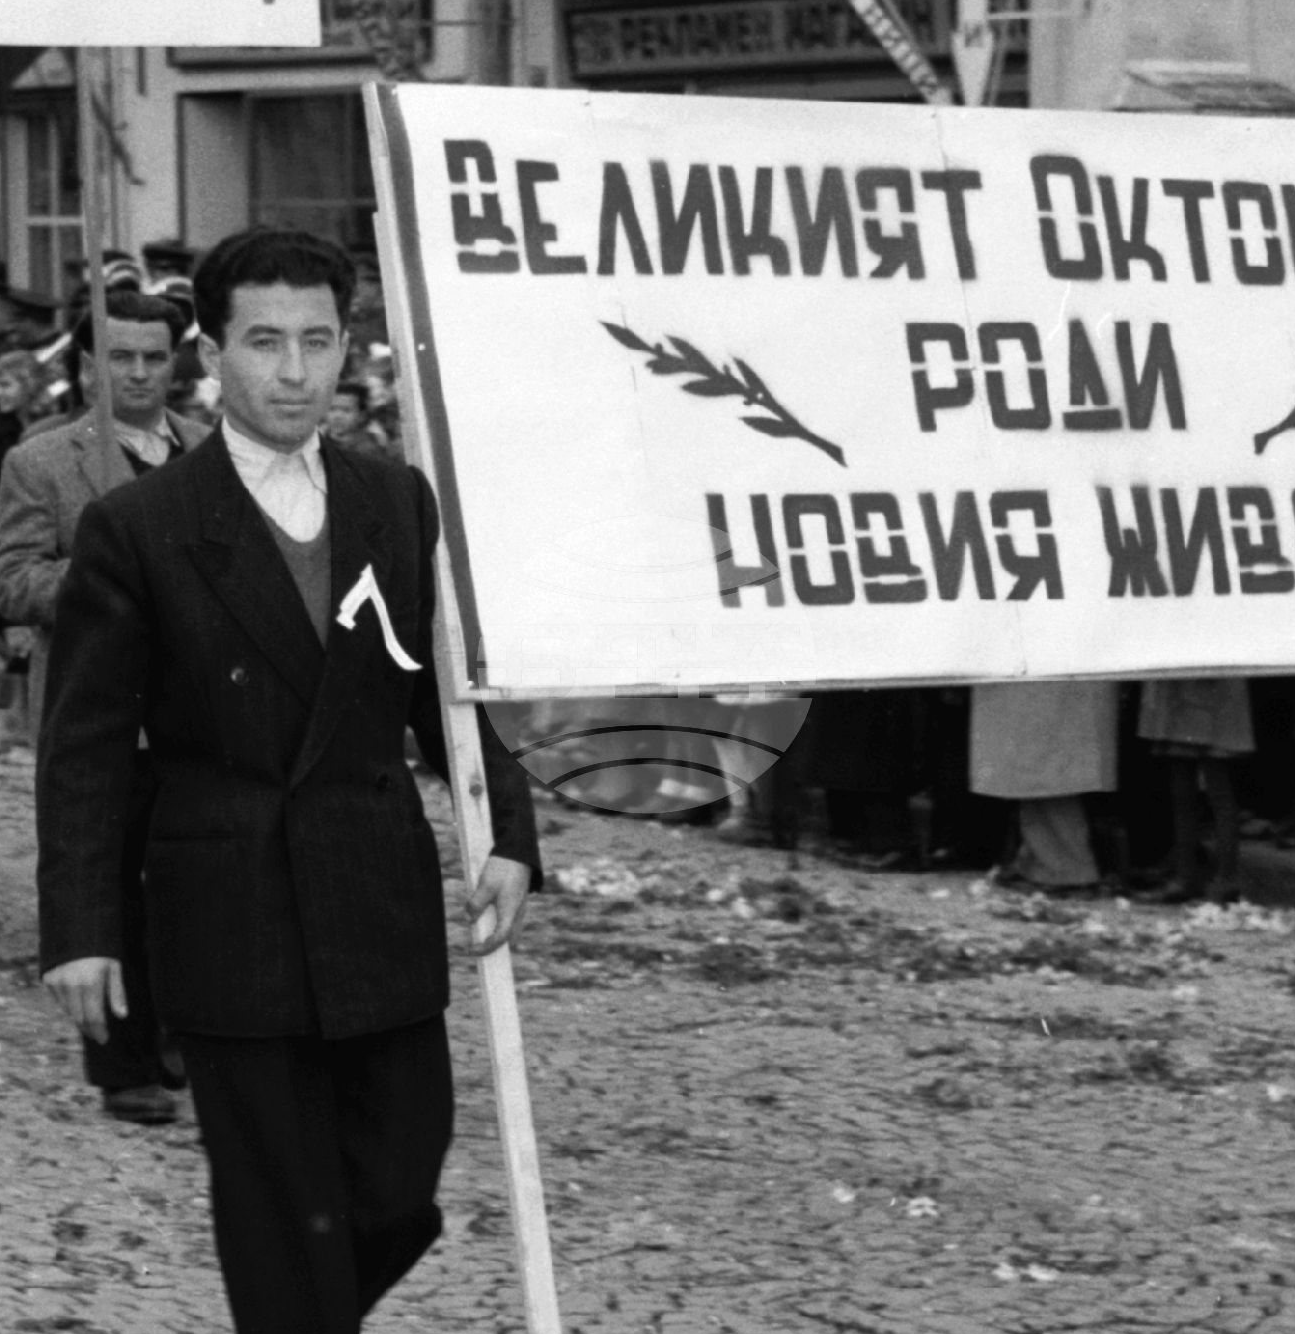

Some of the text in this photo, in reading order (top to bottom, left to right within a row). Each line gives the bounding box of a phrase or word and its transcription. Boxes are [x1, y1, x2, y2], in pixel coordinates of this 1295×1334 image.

[442, 138, 983, 281] ВЕЛИКИЯТ
[904, 318, 1188, 433] РОДИ
[705, 489, 1065, 609] НОВИЯ
